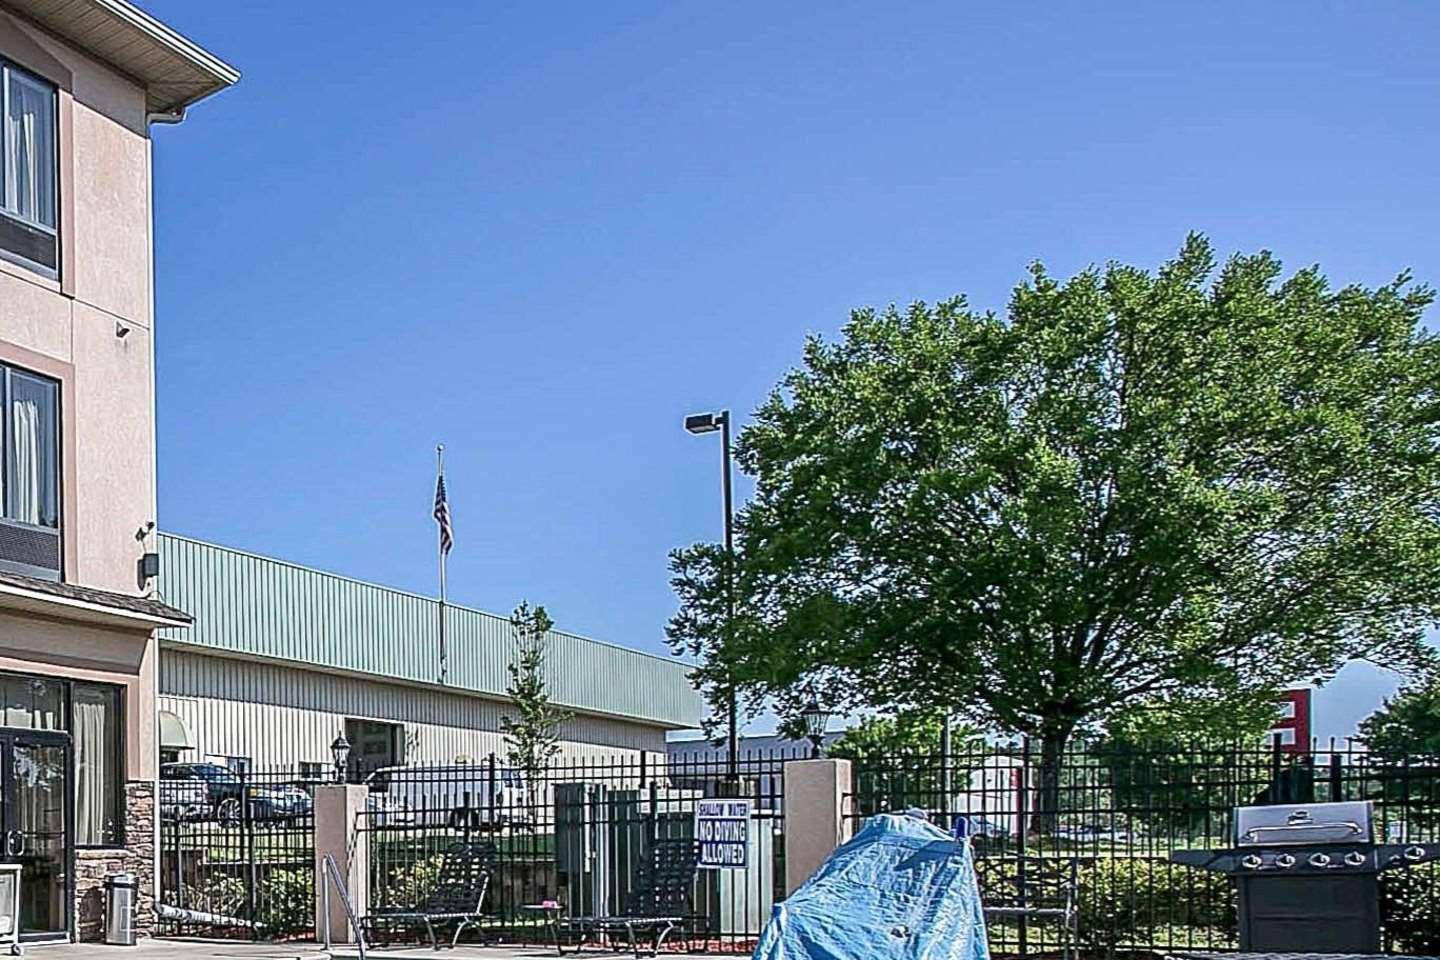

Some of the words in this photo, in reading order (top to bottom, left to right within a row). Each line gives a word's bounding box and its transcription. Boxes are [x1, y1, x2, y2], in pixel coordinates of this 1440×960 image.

[728, 803, 747, 816] WATER
[699, 820, 713, 841] NO
[714, 820, 746, 841] DIVING
[701, 843, 744, 864] ALLOWED
